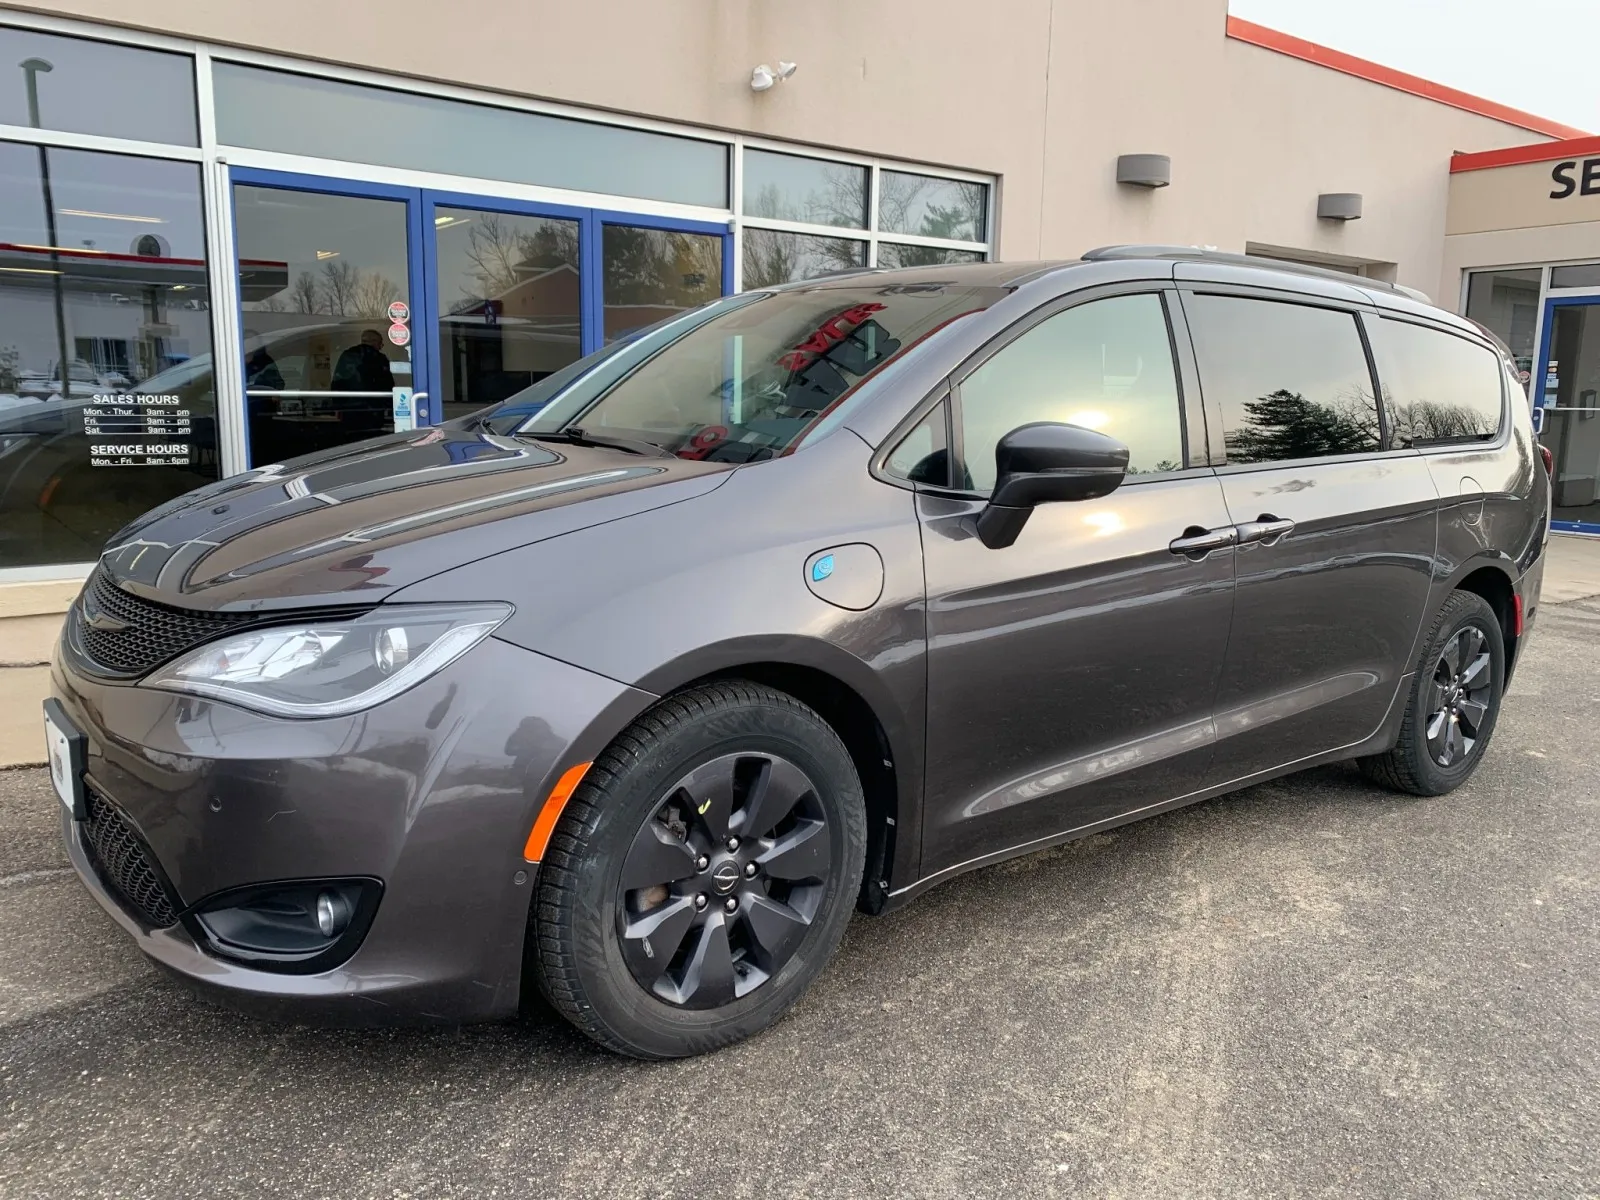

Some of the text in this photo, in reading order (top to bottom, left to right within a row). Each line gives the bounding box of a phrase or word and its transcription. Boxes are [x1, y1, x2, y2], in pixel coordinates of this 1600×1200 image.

[1550, 158, 1600, 199] SE
[93, 395, 179, 404] SALES HOURS
[83, 408, 105, 416] Mon.
[112, 408, 135, 416] Thur.
[146, 408, 164, 416] 9am
[84, 417, 98, 425] Fri.
[85, 426, 102, 434] Sat.
[90, 444, 188, 454] SERVICE HOURS
[91, 458, 112, 466] Mon.
[171, 457, 189, 465] 6pm
